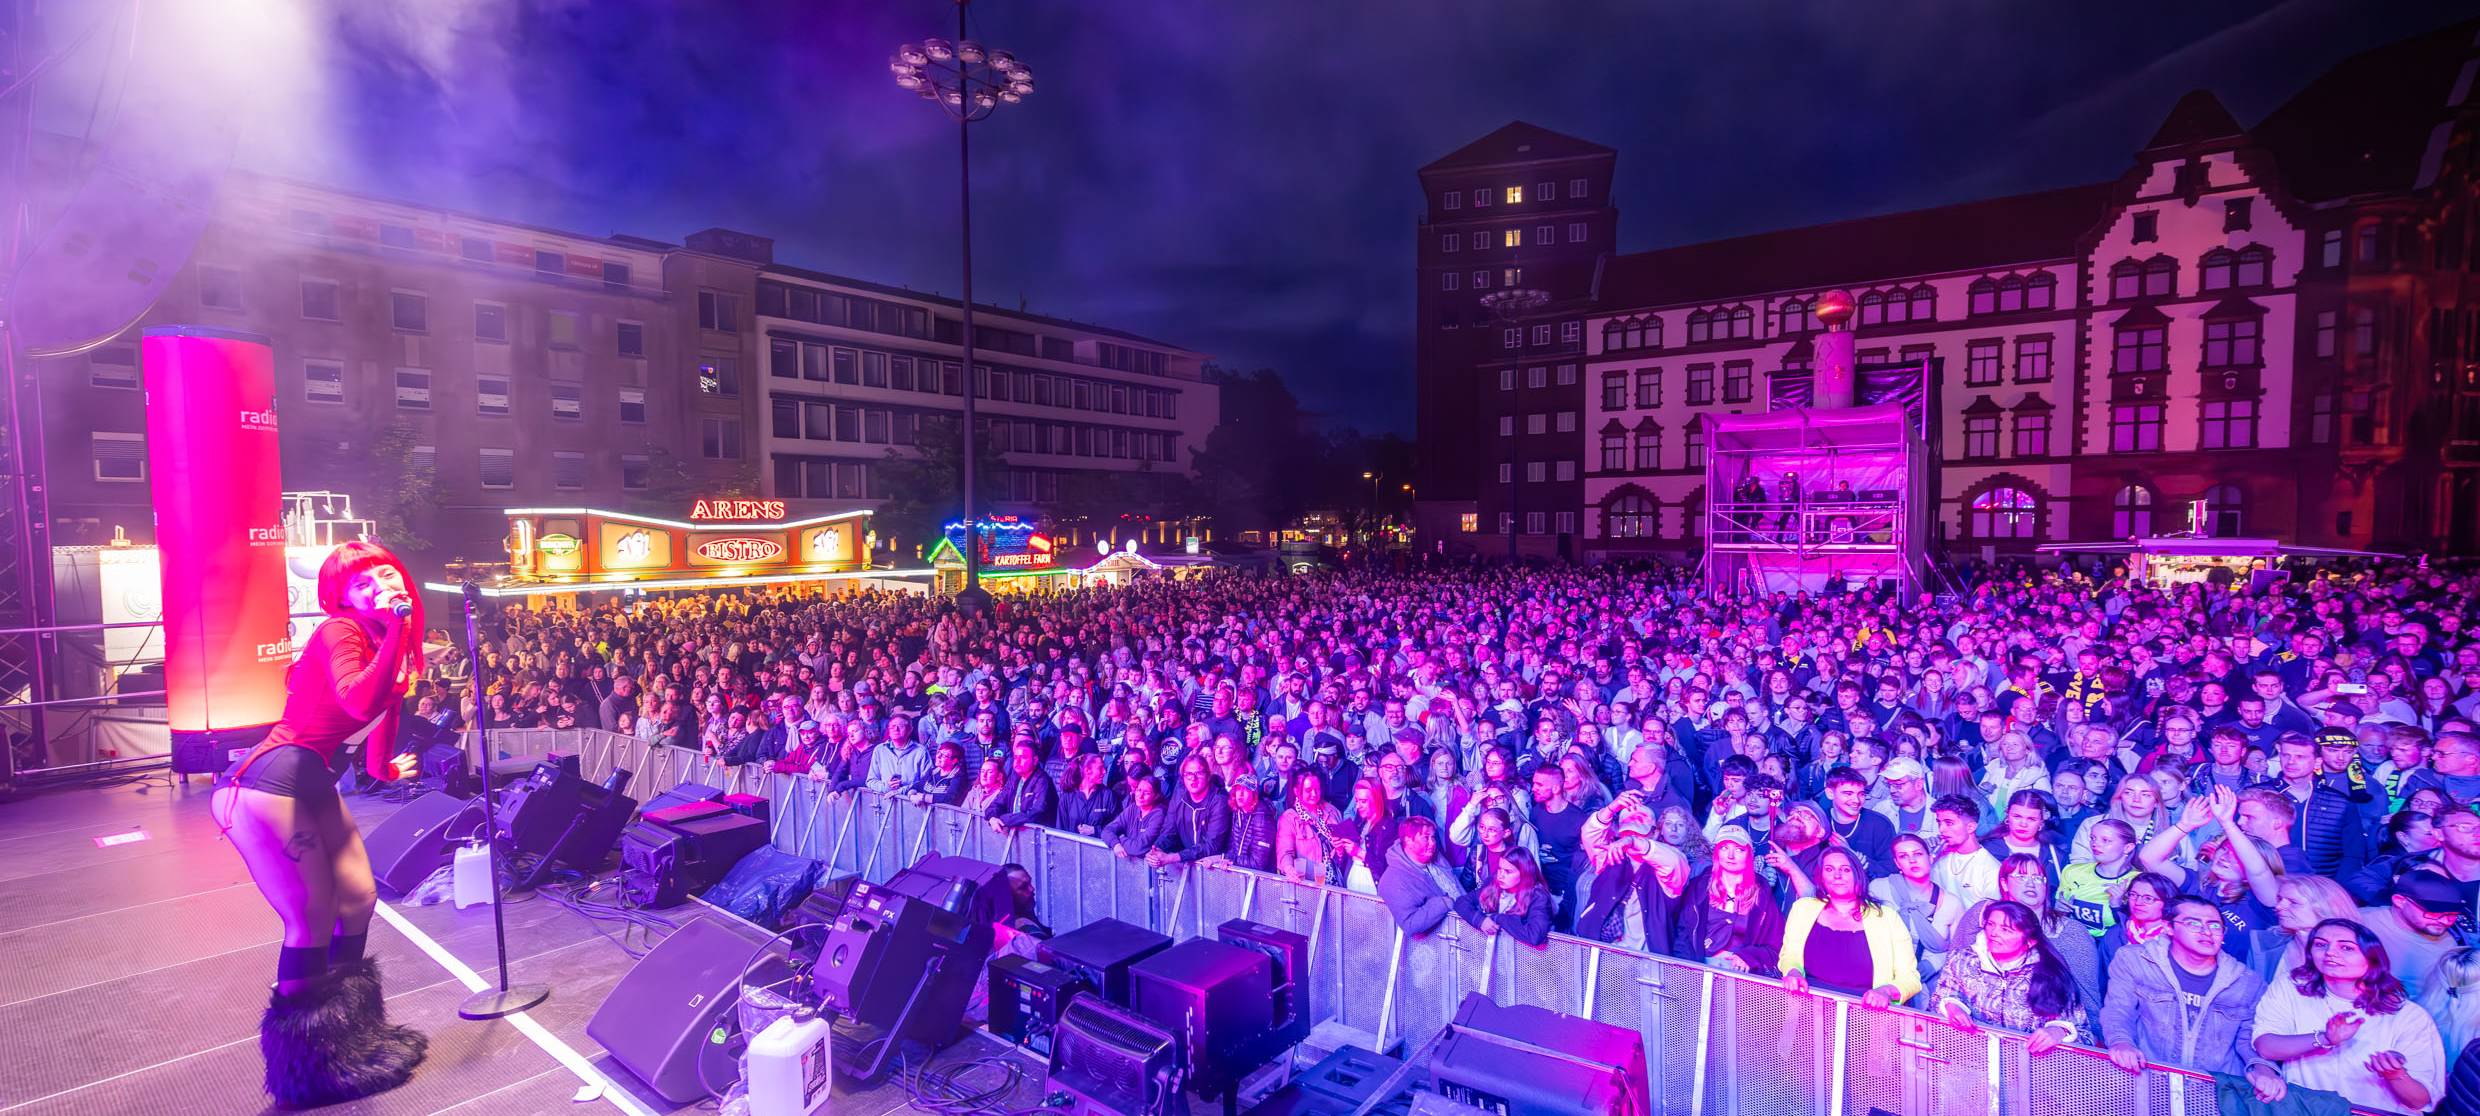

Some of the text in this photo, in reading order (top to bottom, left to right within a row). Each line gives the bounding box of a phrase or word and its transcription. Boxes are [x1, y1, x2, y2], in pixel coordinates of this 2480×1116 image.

[690, 499, 785, 520] ARENS
[705, 539, 775, 560] BISTRO
[994, 555, 1032, 566] KARTOFFEL
[2073, 905, 2101, 924] 1&1
